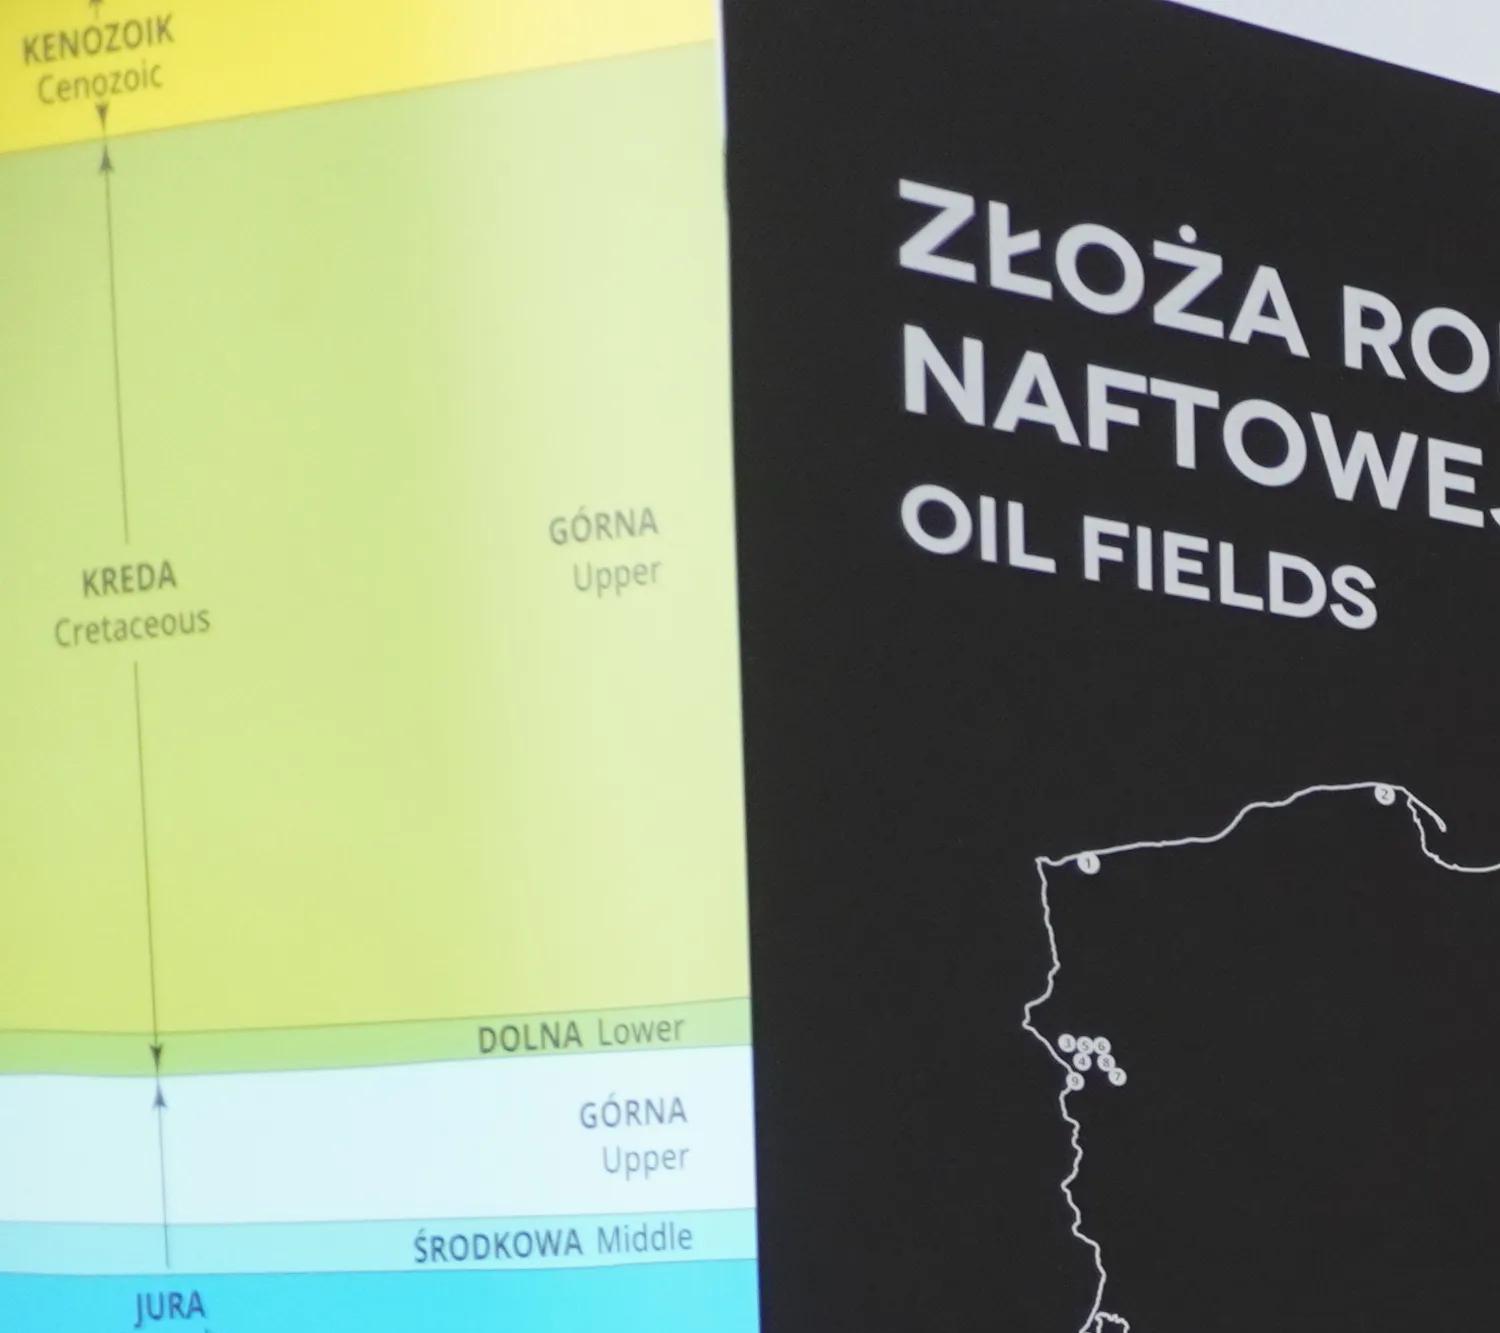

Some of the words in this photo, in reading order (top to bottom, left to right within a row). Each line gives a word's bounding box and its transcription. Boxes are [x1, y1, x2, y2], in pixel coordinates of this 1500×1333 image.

[23, 14, 174, 65] KENOZOIK
[37, 59, 163, 105] Cenozoic
[898, 177, 1310, 359] ZŁOŻA
[548, 506, 659, 546] GÓRNA
[900, 483, 1057, 573] OIL
[1082, 514, 1379, 631] FIELDS
[82, 560, 177, 597] KREDA
[573, 561, 662, 597] Upper
[54, 609, 211, 649] Cretaceous
[478, 1020, 584, 1055] DOLNA
[598, 1018, 684, 1046] Lower
[579, 1093, 688, 1129] GÓRNA
[602, 1146, 690, 1180] Upper
[413, 1228, 584, 1262] ŚRODKOWA
[597, 1222, 692, 1253] Middle
[134, 1289, 206, 1327] JURA
